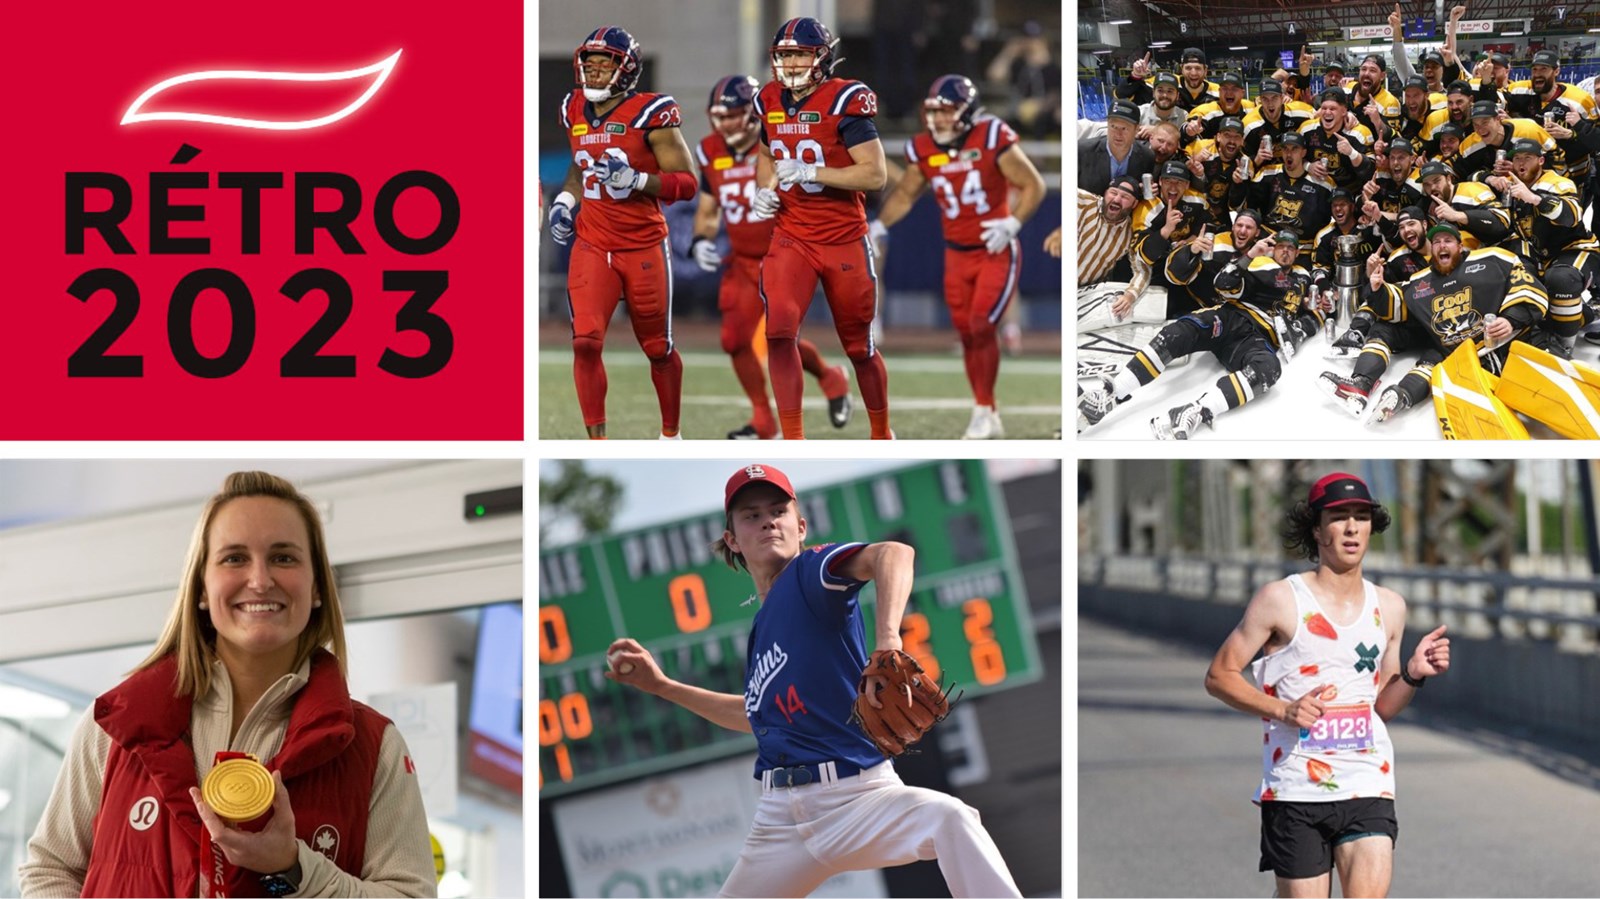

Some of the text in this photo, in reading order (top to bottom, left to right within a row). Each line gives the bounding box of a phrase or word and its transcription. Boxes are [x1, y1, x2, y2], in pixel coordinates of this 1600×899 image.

[660, 107, 680, 127] 23
[859, 92, 878, 114] 39
[1433, 288, 1470, 313] Cool
[668, 573, 712, 633] 0
[962, 597, 994, 642] 2
[539, 604, 573, 664] 0
[970, 640, 1006, 686] 0
[774, 682, 808, 723] 14
[1313, 717, 1367, 740] 3123
[211, 845, 225, 886] JING
